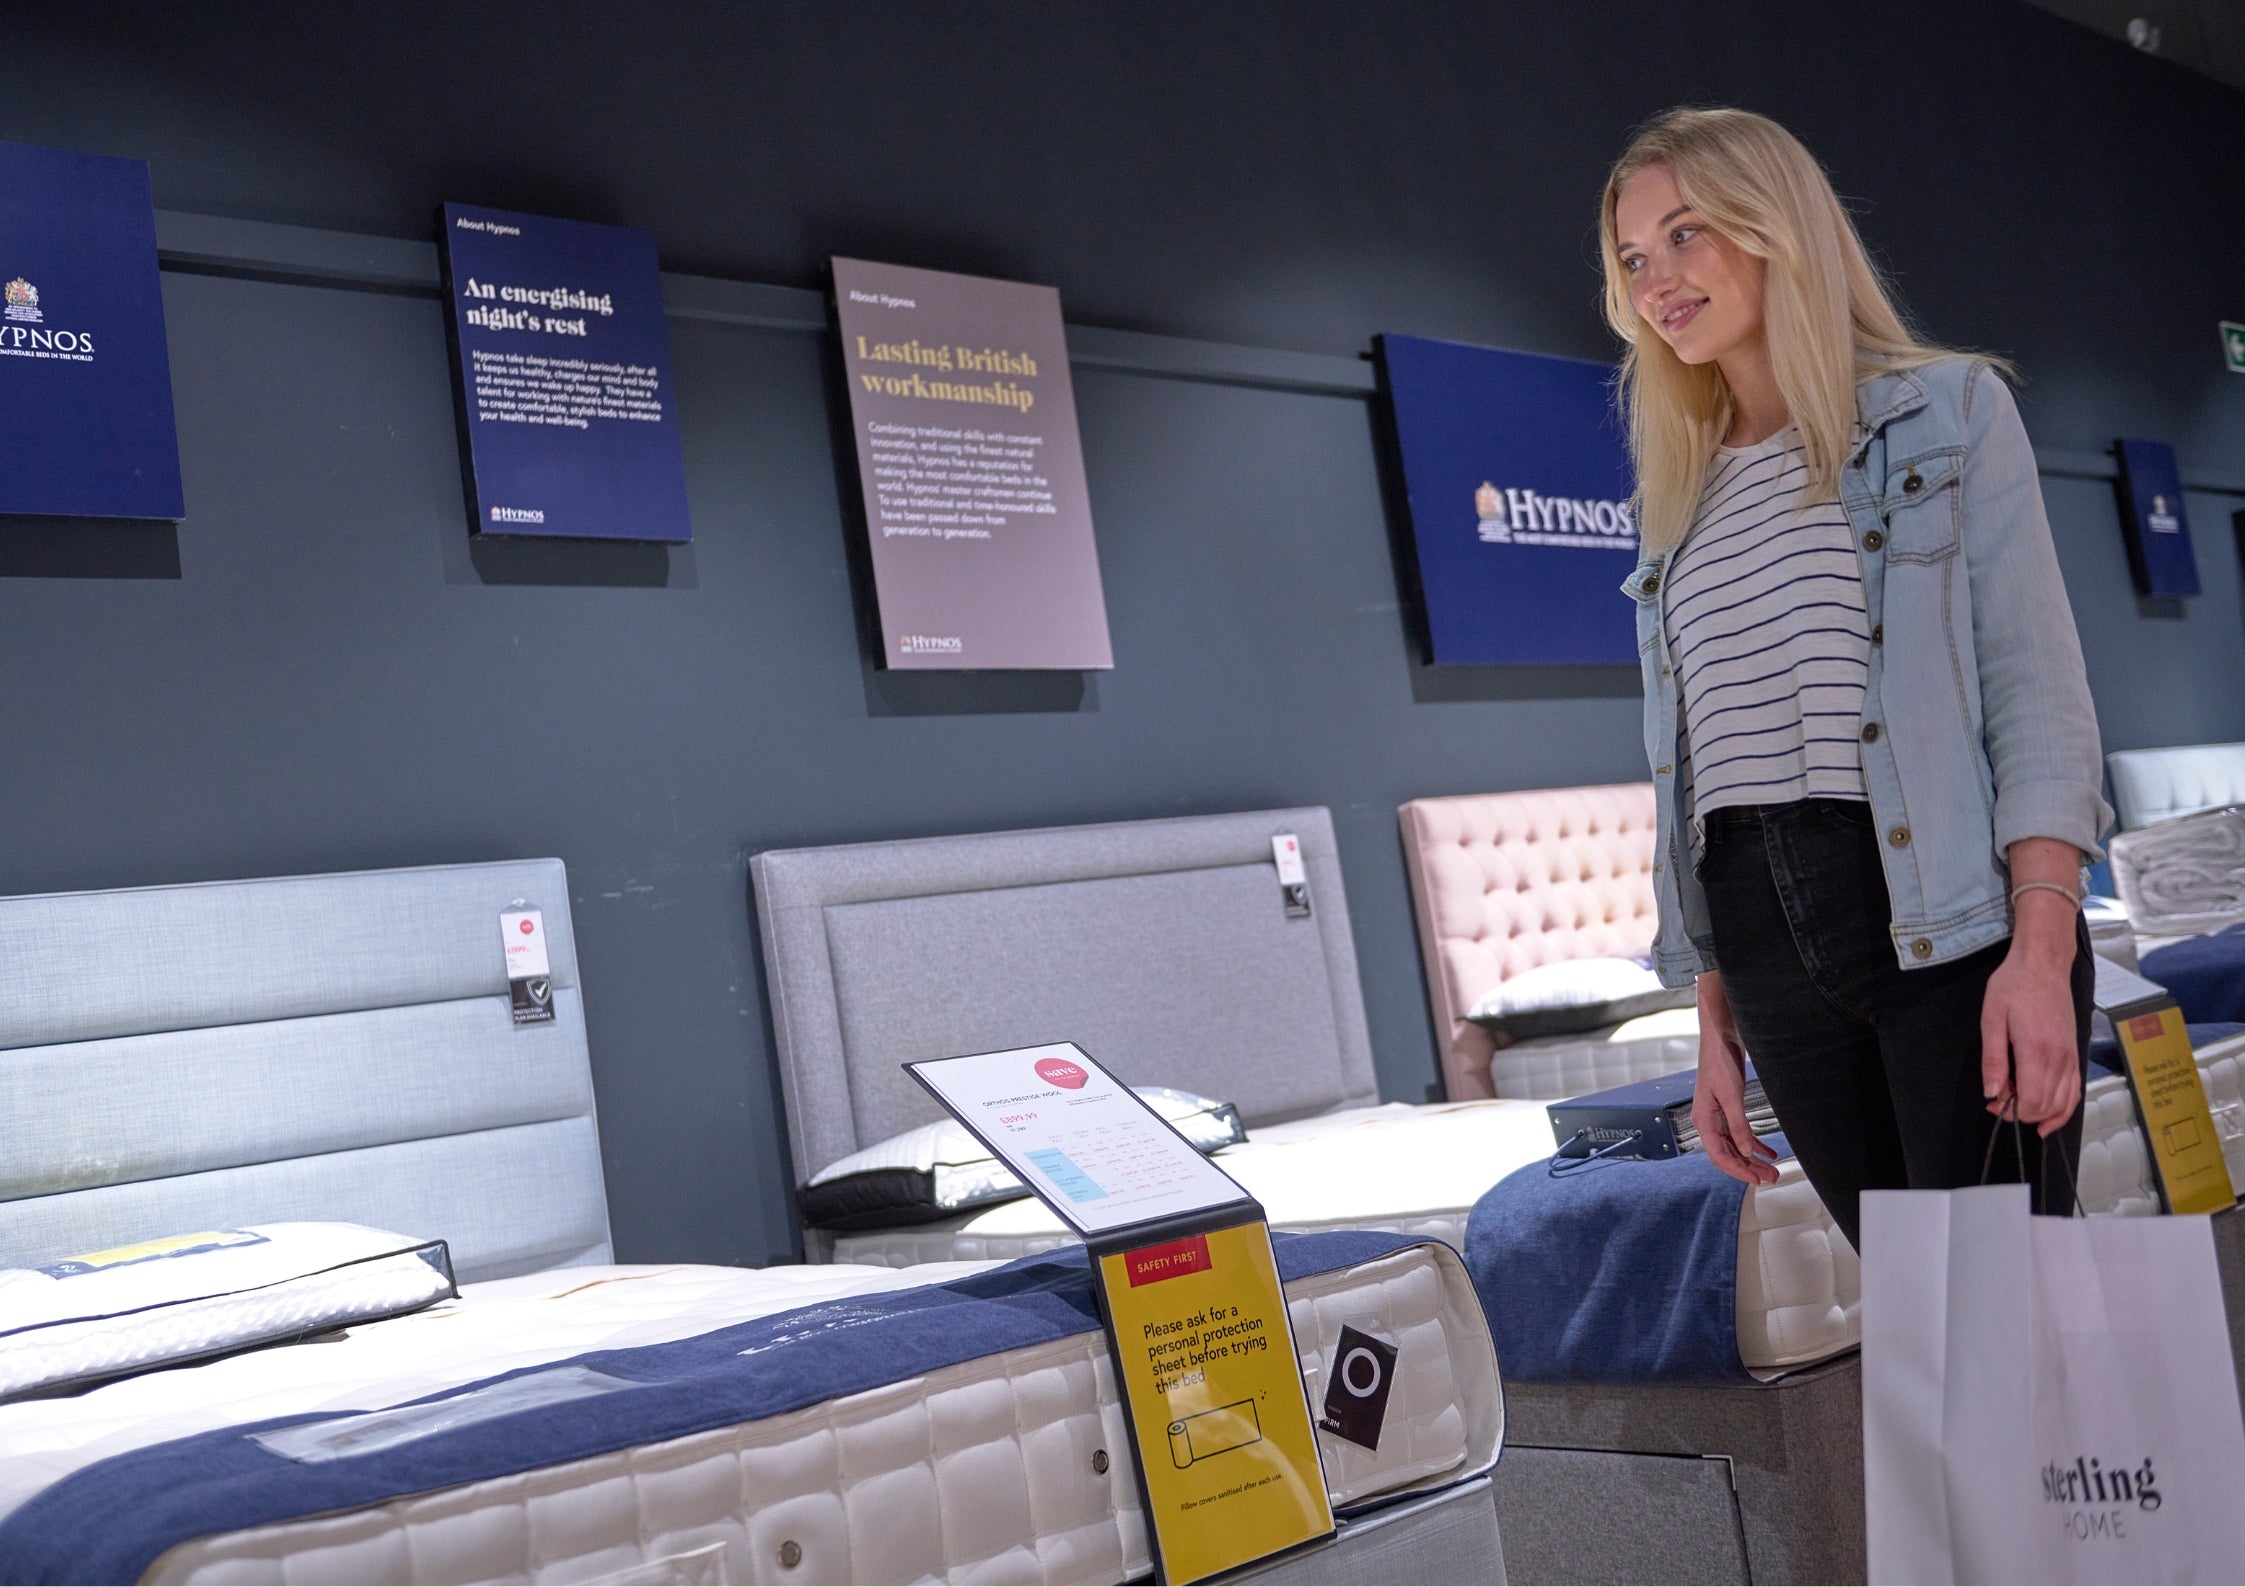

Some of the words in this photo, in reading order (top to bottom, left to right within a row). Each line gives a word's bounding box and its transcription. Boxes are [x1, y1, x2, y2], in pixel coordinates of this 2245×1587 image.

[457, 217, 485, 231] About
[486, 221, 521, 236] Hypnos
[464, 277, 496, 299] An
[500, 285, 614, 317] energising
[850, 290, 879, 304] About
[880, 294, 916, 309] Hypnos
[466, 305, 541, 332] night's
[544, 318, 587, 337] rest
[0, 326, 93, 353] YPNOS
[857, 335, 953, 371] Lasting
[956, 347, 1038, 377] British
[861, 373, 1035, 413] workmanship
[502, 507, 545, 520] HYPNOS
[1505, 488, 1635, 537] HYPNOS
[1044, 1066, 1078, 1079] save
[1137, 1256, 1170, 1274] SAFETY
[1173, 1251, 1197, 1265] FIRST
[1143, 1320, 1183, 1339] Please
[1186, 1310, 1207, 1329] ask
[1209, 1306, 1227, 1323] for
[1231, 1306, 1238, 1317] a
[1148, 1331, 1200, 1362] personal
[1203, 1318, 1263, 1349] protection
[1152, 1355, 1187, 1376] sheet
[1189, 1345, 1228, 1366] before
[1231, 1336, 1267, 1356] trying
[1155, 1377, 1180, 1395] this
[1182, 1367, 1206, 1387] bed
[1180, 1501, 1198, 1512] Pillow
[1198, 1495, 1217, 1506] covers
[1217, 1484, 1243, 1500] sanitised
[1243, 1481, 1257, 1491] after
[1258, 1475, 1271, 1486] each
[1272, 1473, 1284, 1481] use.
[2041, 1456, 2162, 1511] sterling
[2063, 1510, 2128, 1541] HOME
